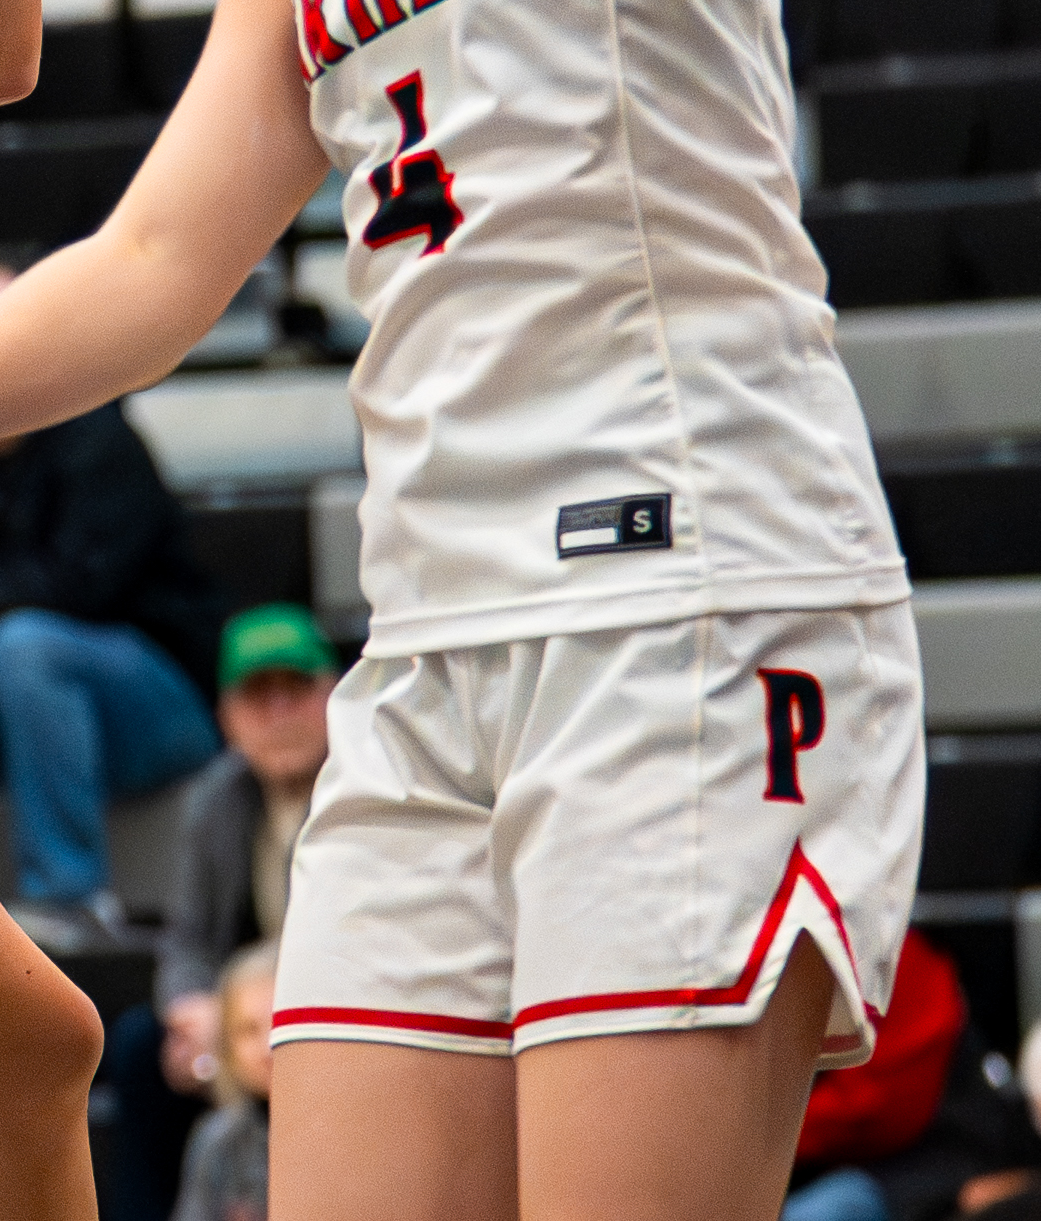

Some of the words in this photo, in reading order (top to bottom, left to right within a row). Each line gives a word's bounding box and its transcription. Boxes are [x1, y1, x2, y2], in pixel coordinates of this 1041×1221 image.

[363, 68, 464, 258] 4
[633, 509, 653, 534] S
[756, 667, 827, 805] P
